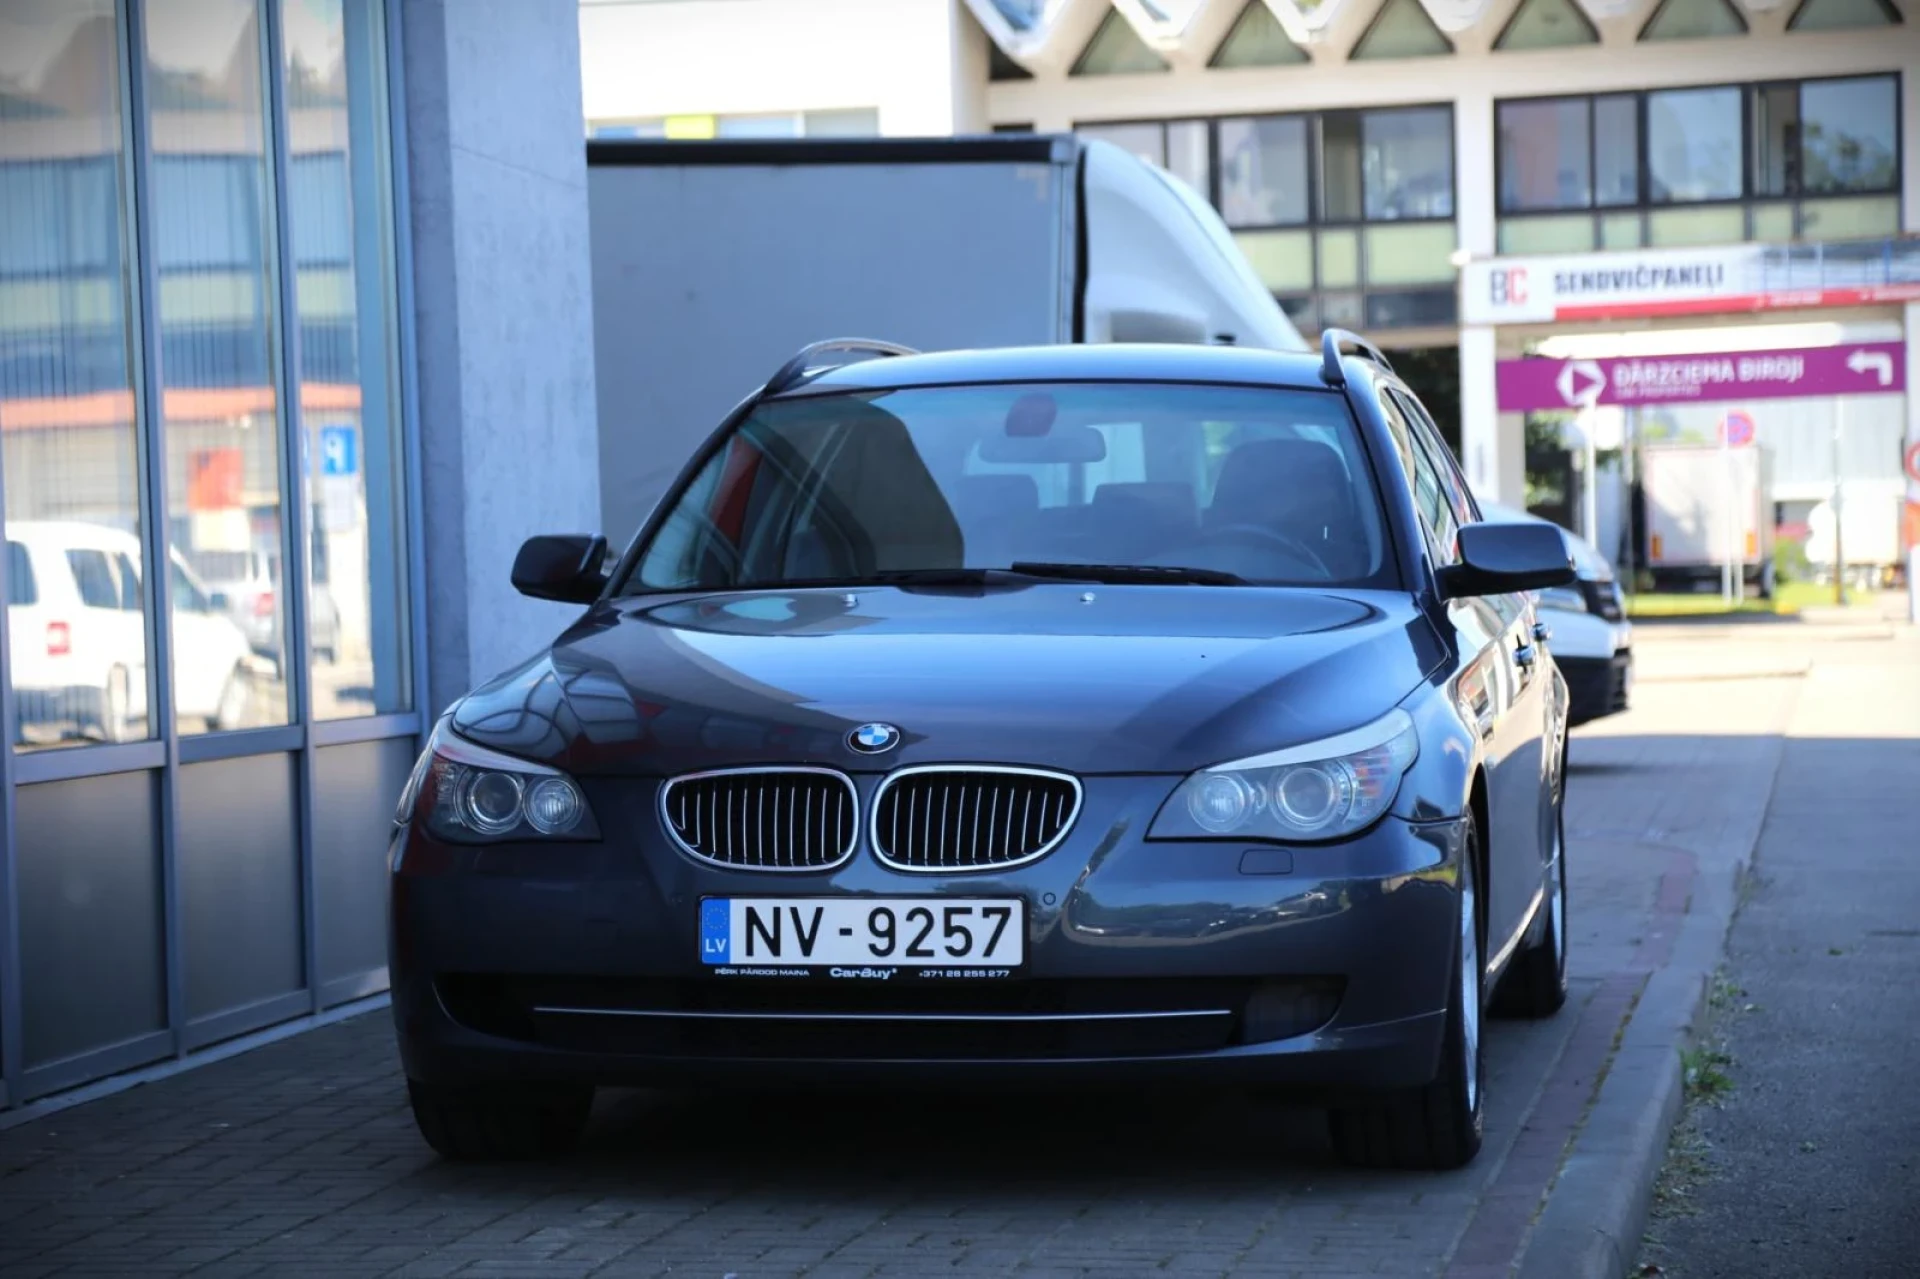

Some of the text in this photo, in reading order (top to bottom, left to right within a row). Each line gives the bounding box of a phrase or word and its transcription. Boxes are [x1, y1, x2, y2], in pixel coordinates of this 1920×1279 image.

[1490, 267, 1528, 305] BC
[1738, 355, 1804, 382] BIROJI
[705, 939, 726, 953] LV
